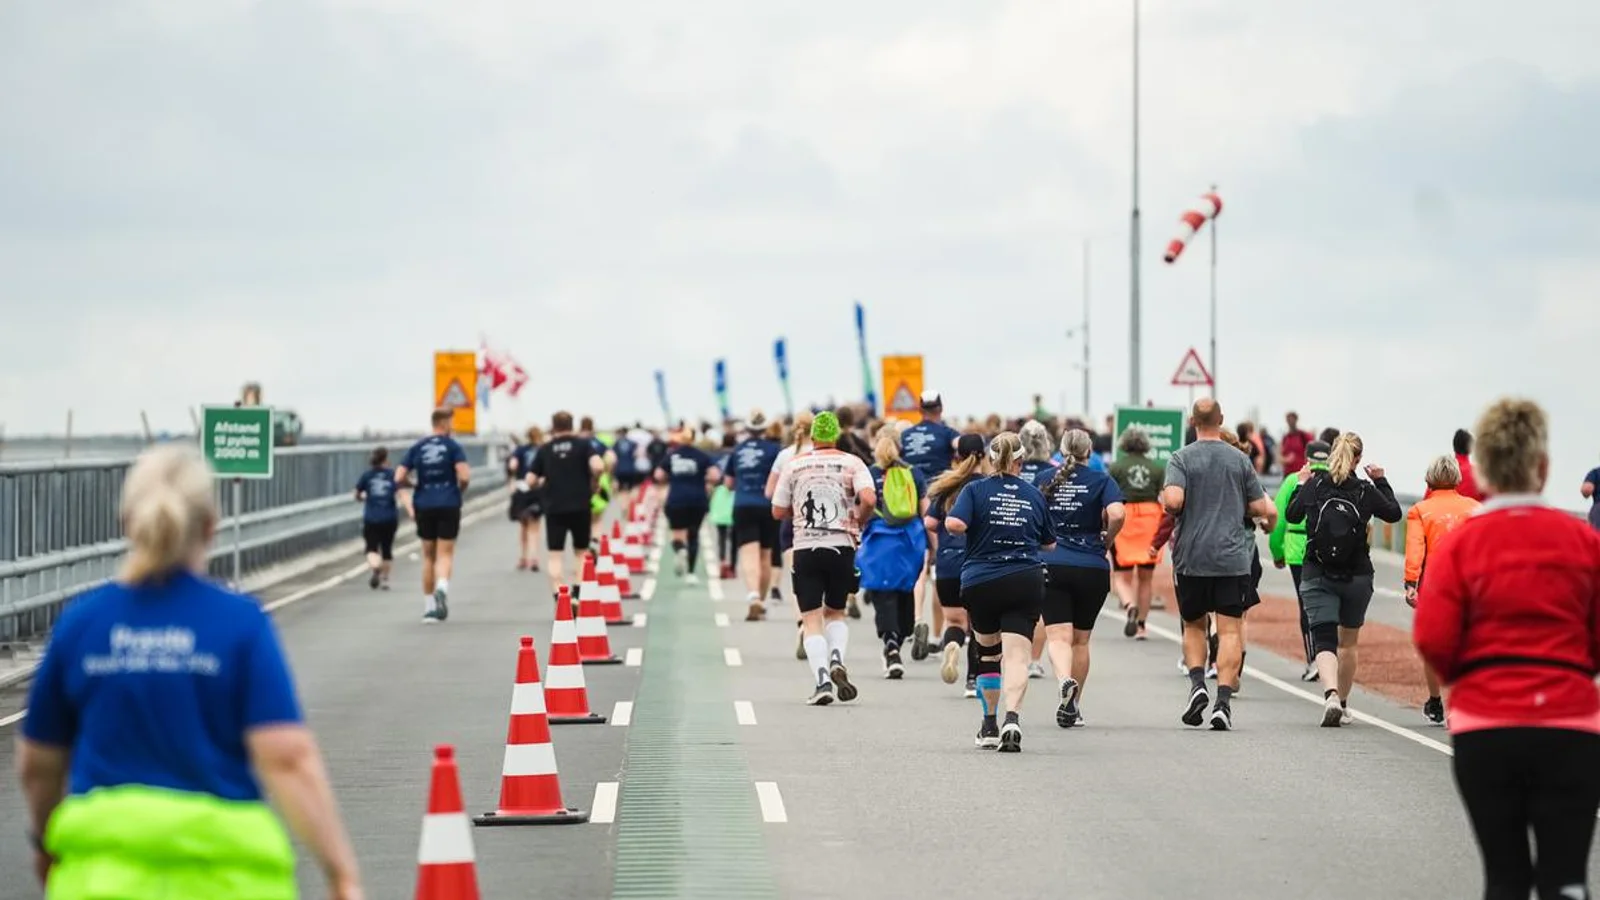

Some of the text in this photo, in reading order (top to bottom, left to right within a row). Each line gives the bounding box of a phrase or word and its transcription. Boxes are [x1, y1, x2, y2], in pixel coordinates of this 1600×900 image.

[214, 421, 261, 434] Afstand
[214, 434, 260, 448] til pylon
[214, 447, 260, 459] 2000 m
